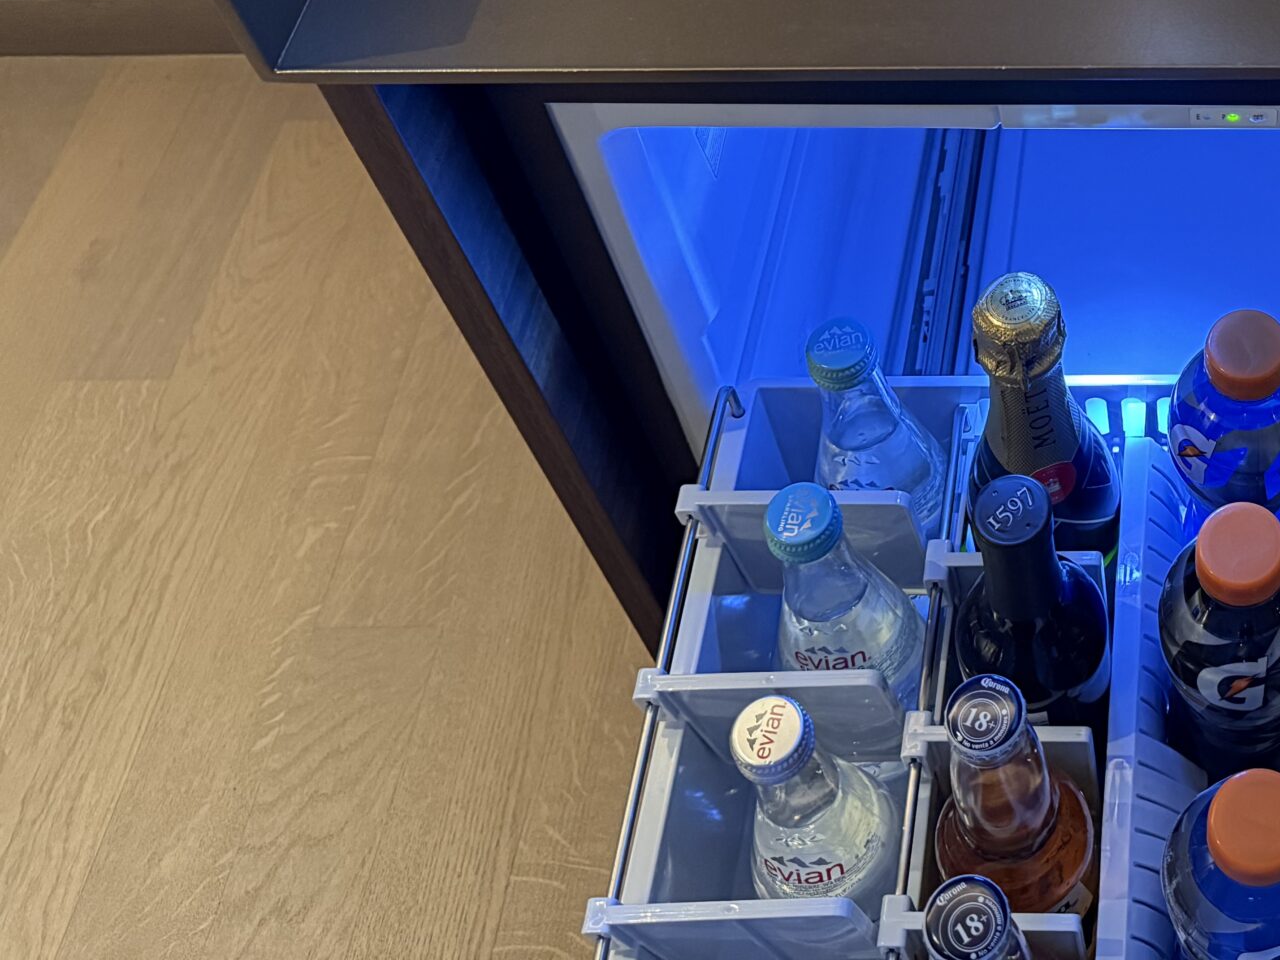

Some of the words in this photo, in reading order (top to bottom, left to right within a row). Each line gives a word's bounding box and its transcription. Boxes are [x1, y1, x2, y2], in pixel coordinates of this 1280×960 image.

[814, 331, 863, 353] evian
[1022, 387, 1057, 450] MOËT
[986, 486, 1034, 530] 1597
[794, 650, 868, 671] evian
[980, 677, 1011, 695] Corona
[756, 703, 787, 760] evian
[961, 739, 971, 748] No
[971, 741, 989, 749] venta
[993, 715, 1008, 742] menores
[962, 707, 996, 732] 18+
[763, 858, 846, 885] evian
[936, 881, 968, 907] Corona
[954, 913, 988, 945] 18+
[977, 949, 988, 957] No
